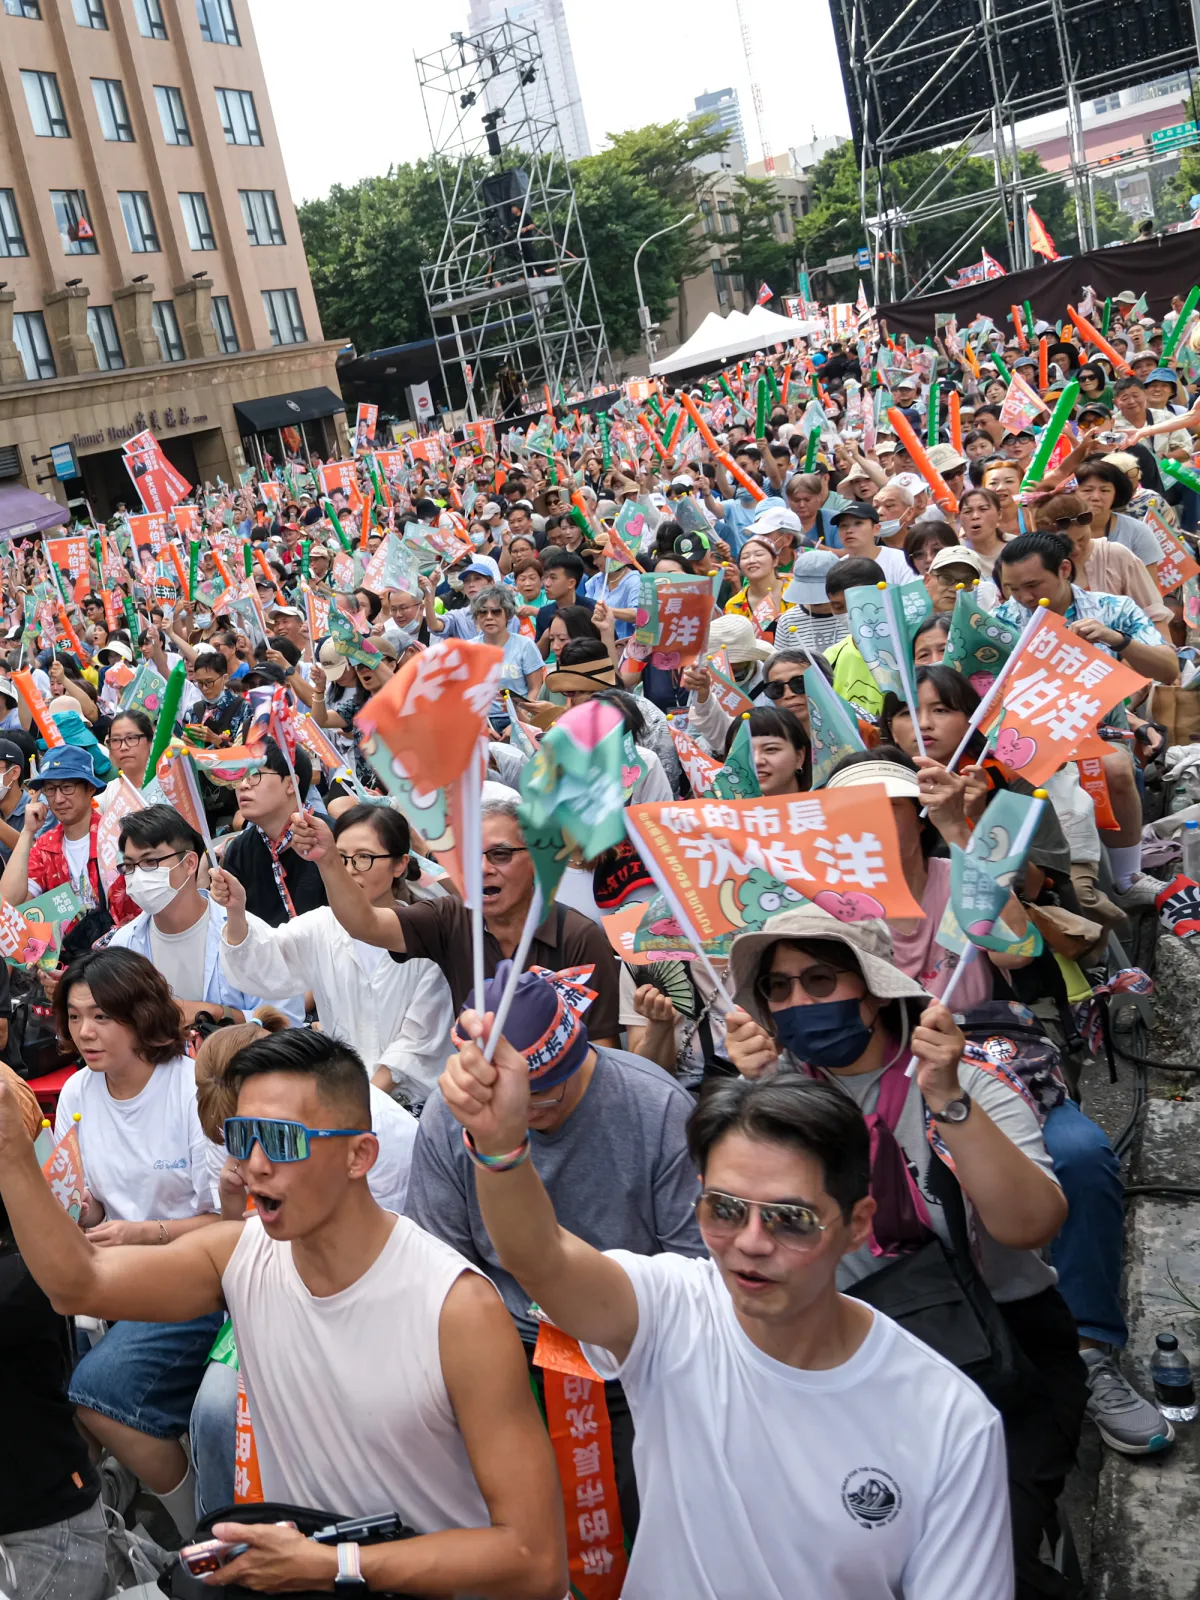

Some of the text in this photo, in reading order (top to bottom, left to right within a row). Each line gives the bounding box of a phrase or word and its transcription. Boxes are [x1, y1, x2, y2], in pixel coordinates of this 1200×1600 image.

[107, 424, 136, 443] Hotel
[148, 519, 161, 554] 沈伯洋
[67, 543, 80, 580] 沈伯洋
[658, 616, 700, 646] 洋
[1027, 626, 1114, 689] 的市長
[1002, 667, 1102, 741] 伯洋
[660, 799, 828, 836] 你的市長
[678, 832, 888, 889] 沈伯洋
[52, 896, 67, 914] 沈伯
[60, 892, 75, 912] 你的市
[686, 894, 715, 935] FUTURE
